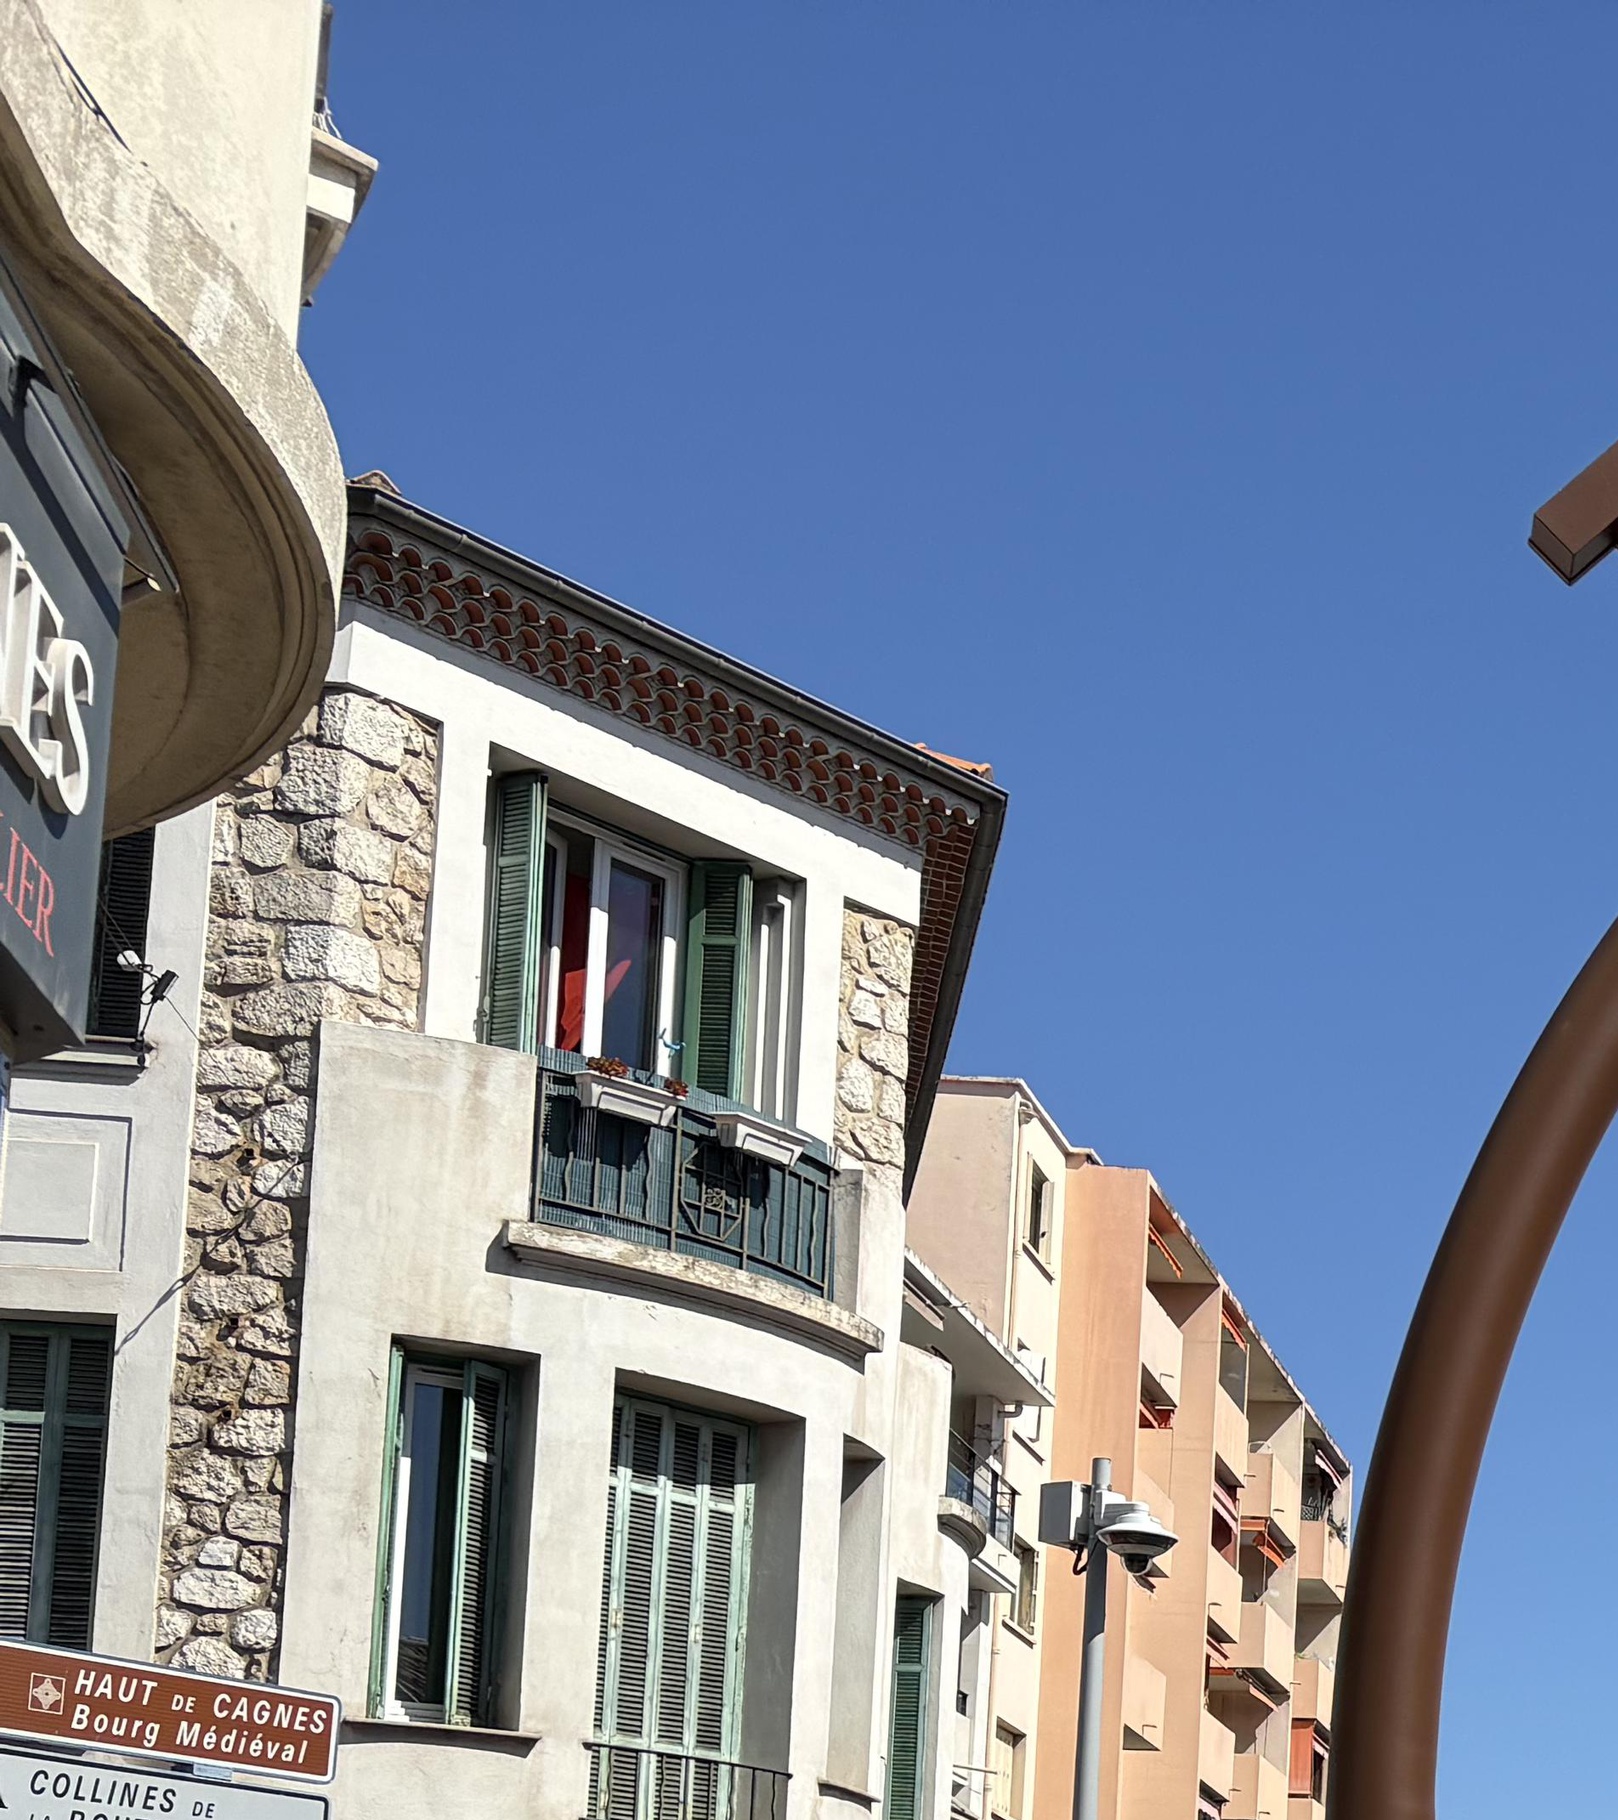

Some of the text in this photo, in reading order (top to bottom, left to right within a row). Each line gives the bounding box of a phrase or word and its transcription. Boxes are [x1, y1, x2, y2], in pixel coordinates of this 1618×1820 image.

[0, 827, 54, 957] IER
[74, 1669, 328, 1734] HAUT DE CAGNES
[70, 1704, 308, 1764] Bourg Médiéval
[30, 1769, 215, 1818] COLLINES DE
